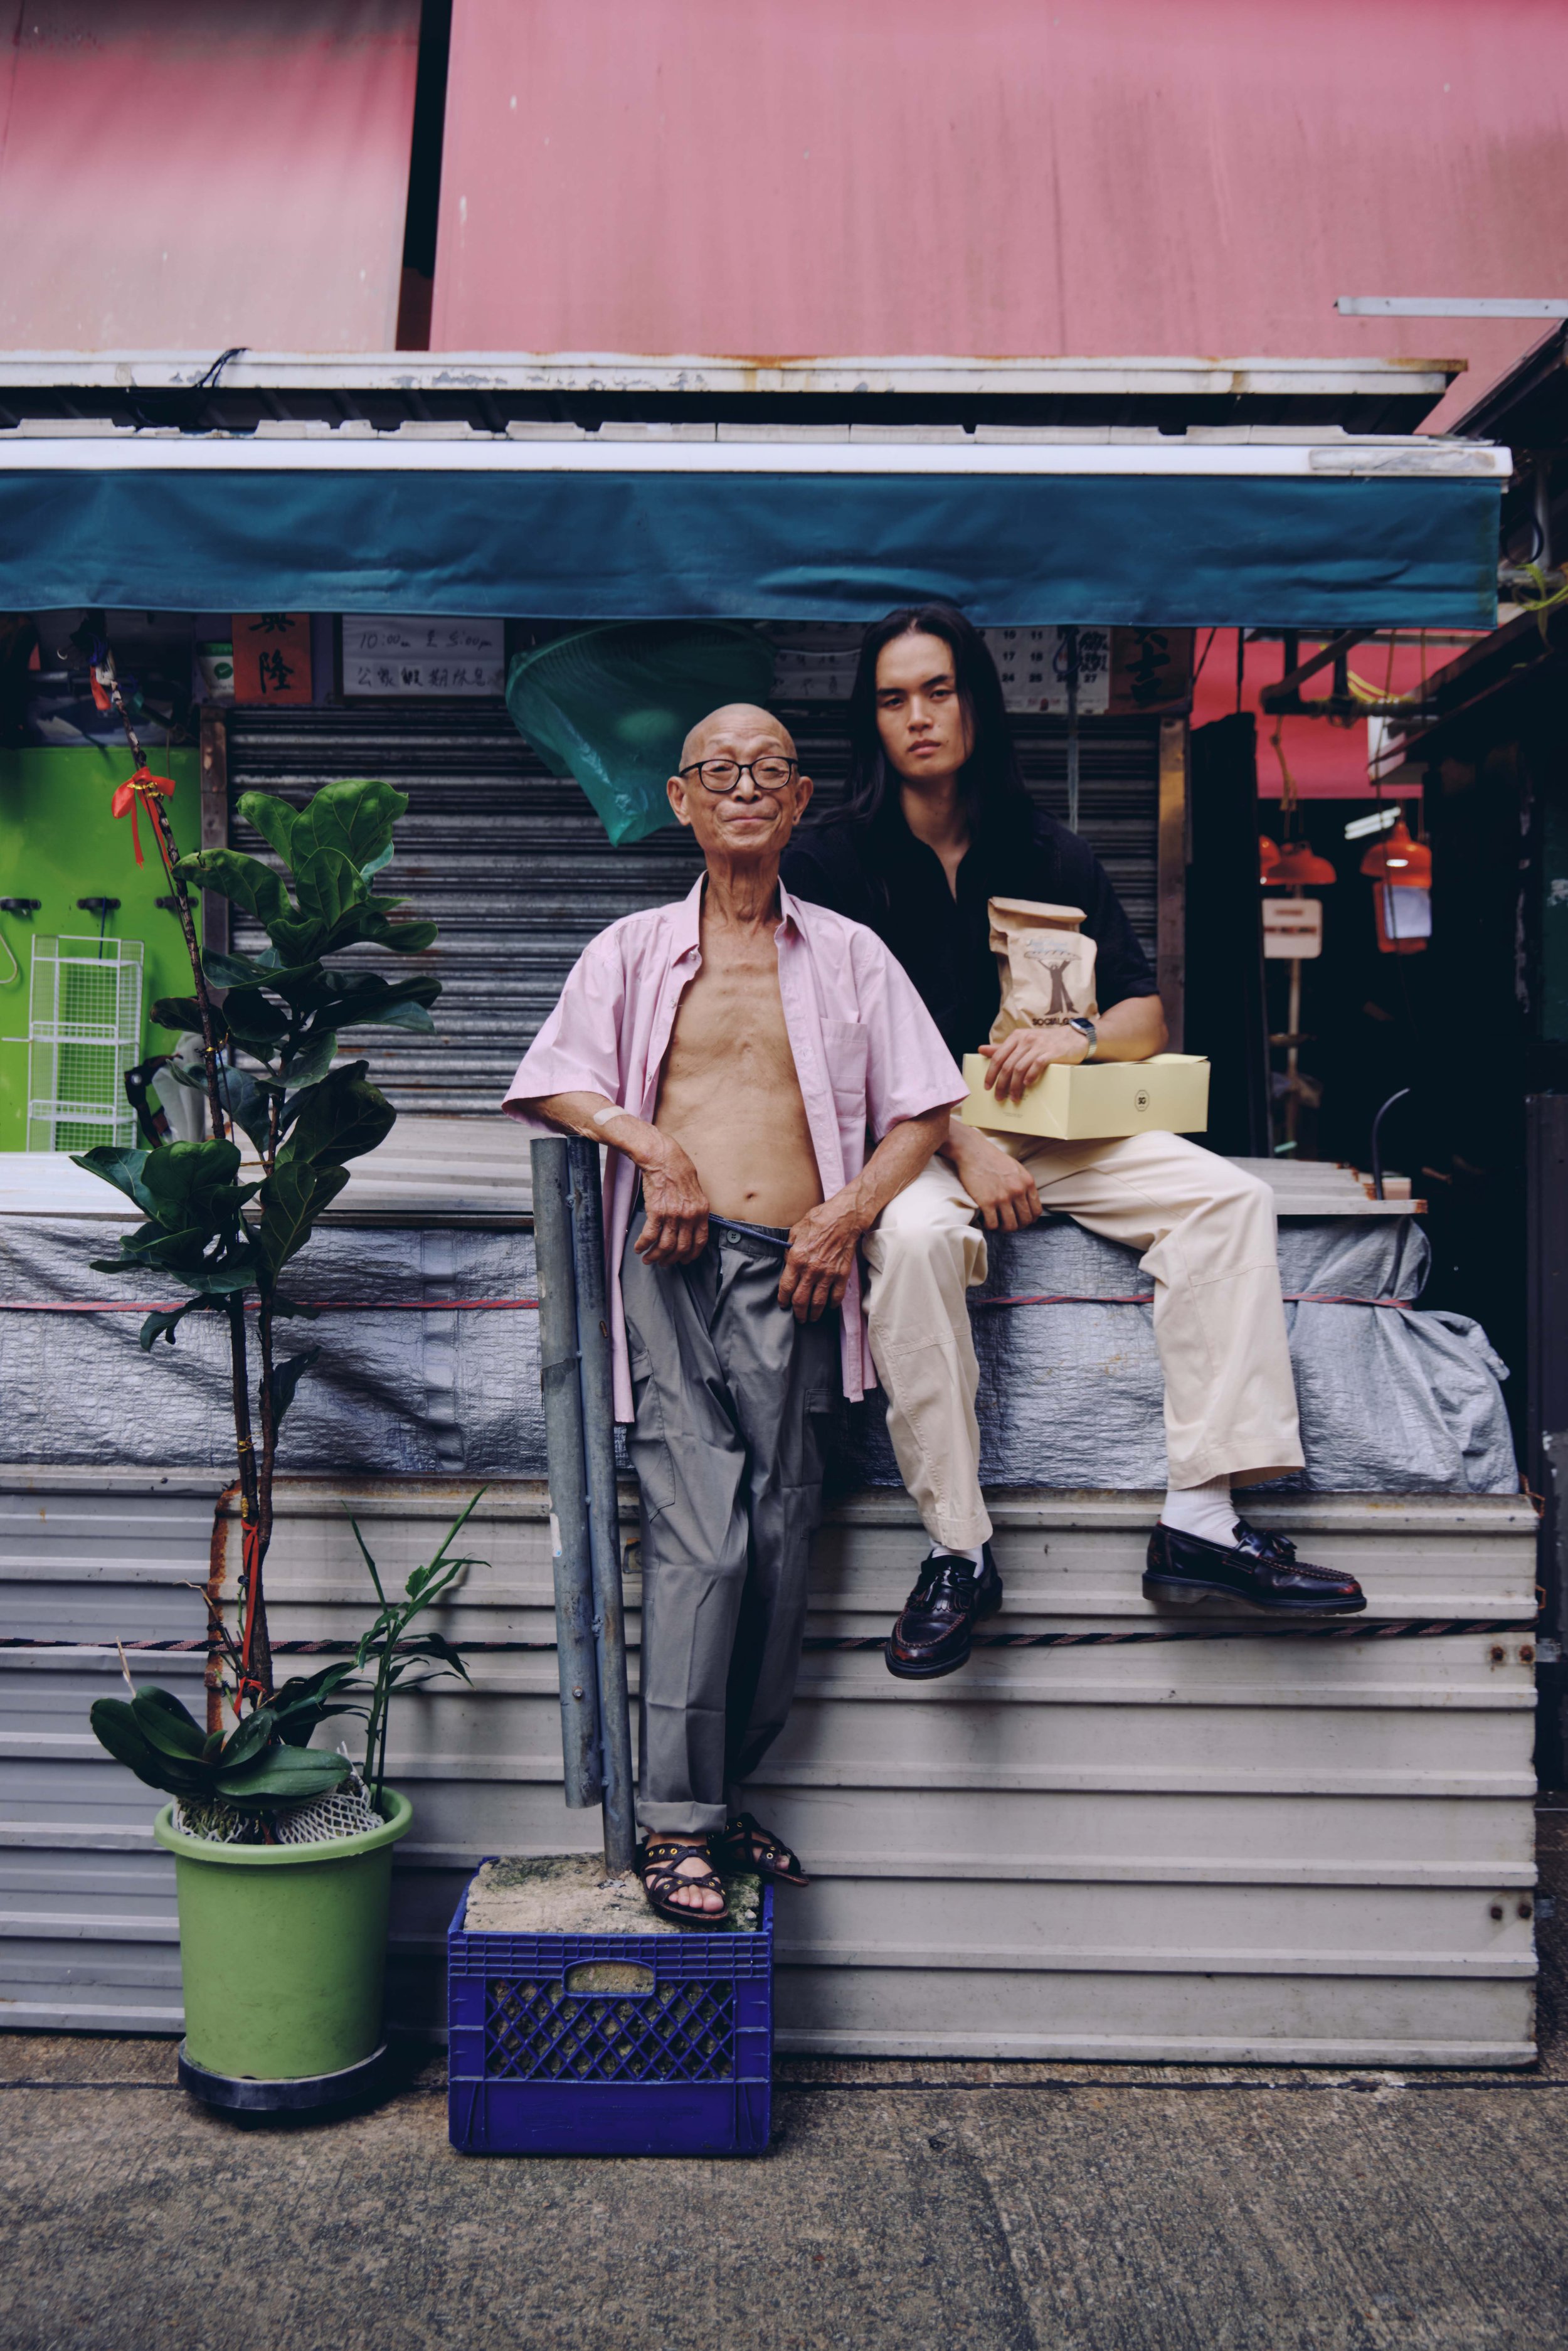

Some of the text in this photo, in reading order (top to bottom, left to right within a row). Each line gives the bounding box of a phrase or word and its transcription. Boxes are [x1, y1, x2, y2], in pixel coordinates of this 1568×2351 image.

[1004, 630, 1016, 640] 10
[1030, 630, 1043, 640] 11
[1003, 651, 1043, 662] 17 18
[1002, 672, 1015, 682] 24
[1029, 672, 1043, 682] 25
[1084, 673, 1098, 683] 27
